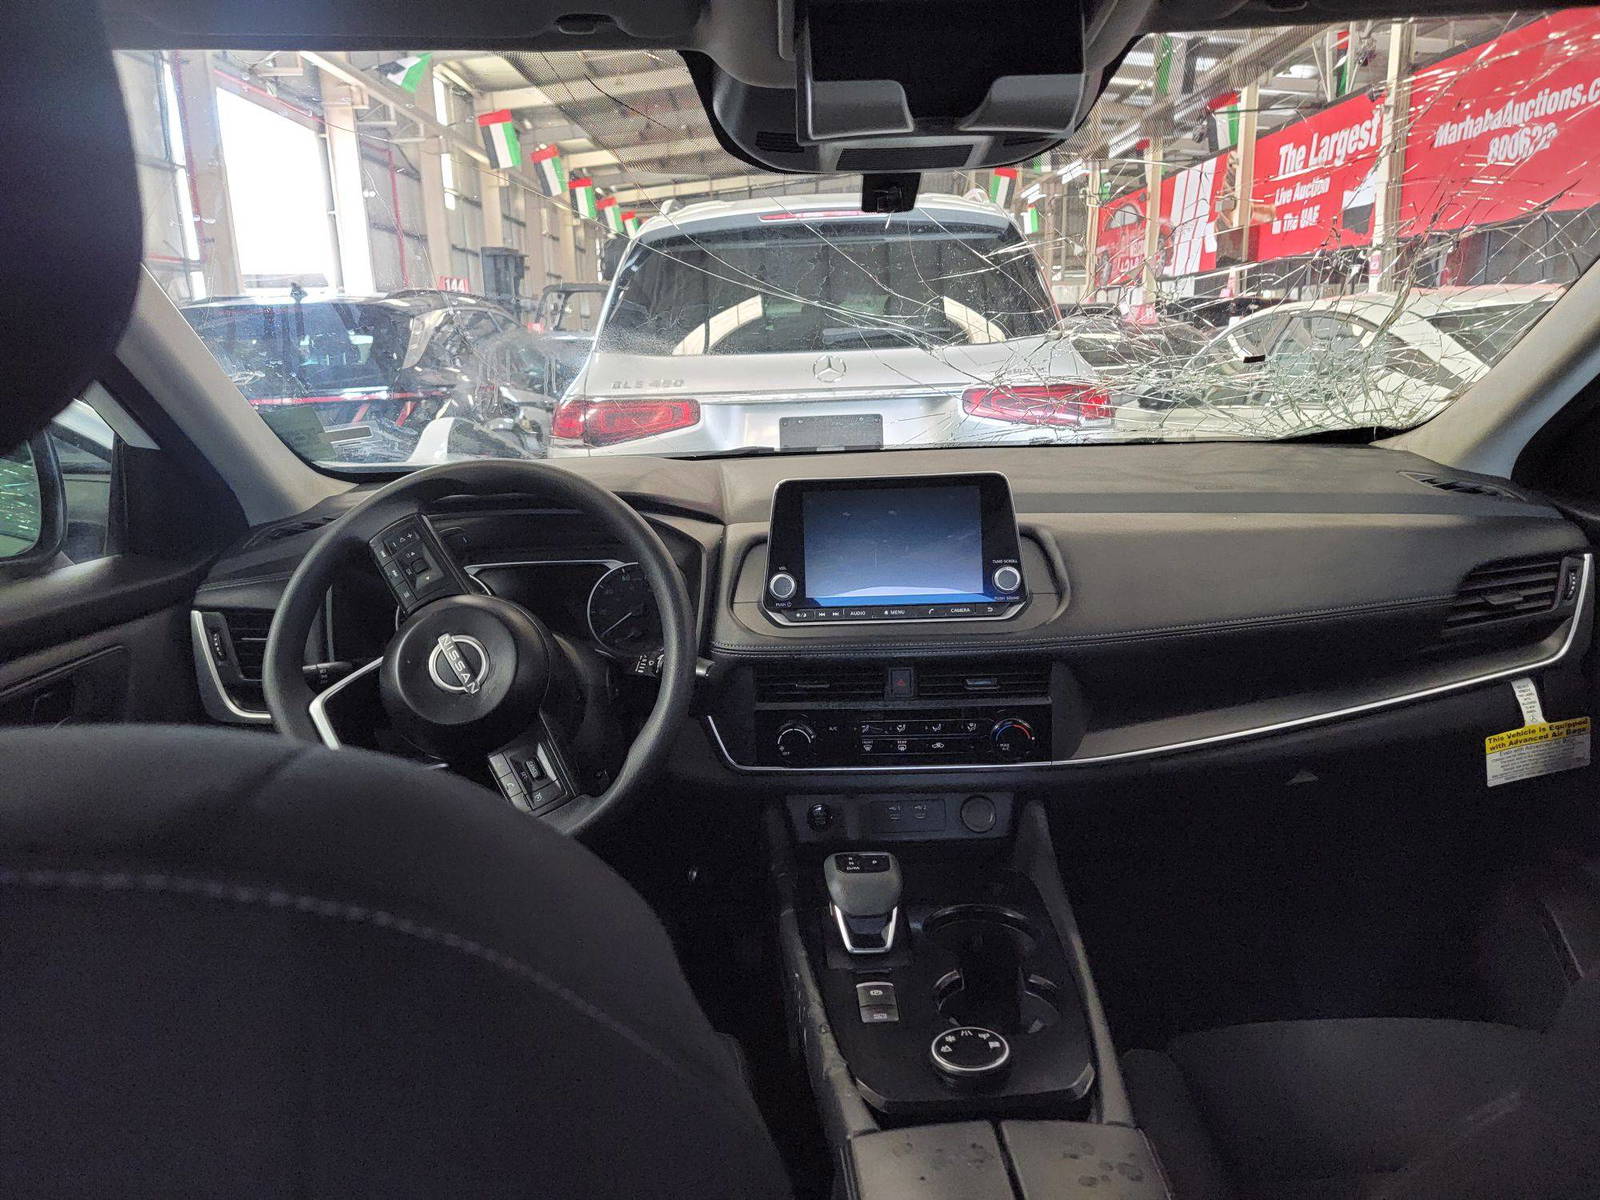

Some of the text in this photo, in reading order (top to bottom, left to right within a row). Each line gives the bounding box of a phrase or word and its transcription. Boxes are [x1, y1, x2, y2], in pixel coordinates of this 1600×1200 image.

[1278, 109, 1380, 177] The Largest
[1274, 175, 1331, 207] Live Auction
[439, 634, 480, 695] NISSAN
[1488, 736, 1505, 744] This
[1507, 728, 1537, 740] Vehicle
[1489, 742, 1507, 752] with
[1508, 734, 1549, 747] Advanced
